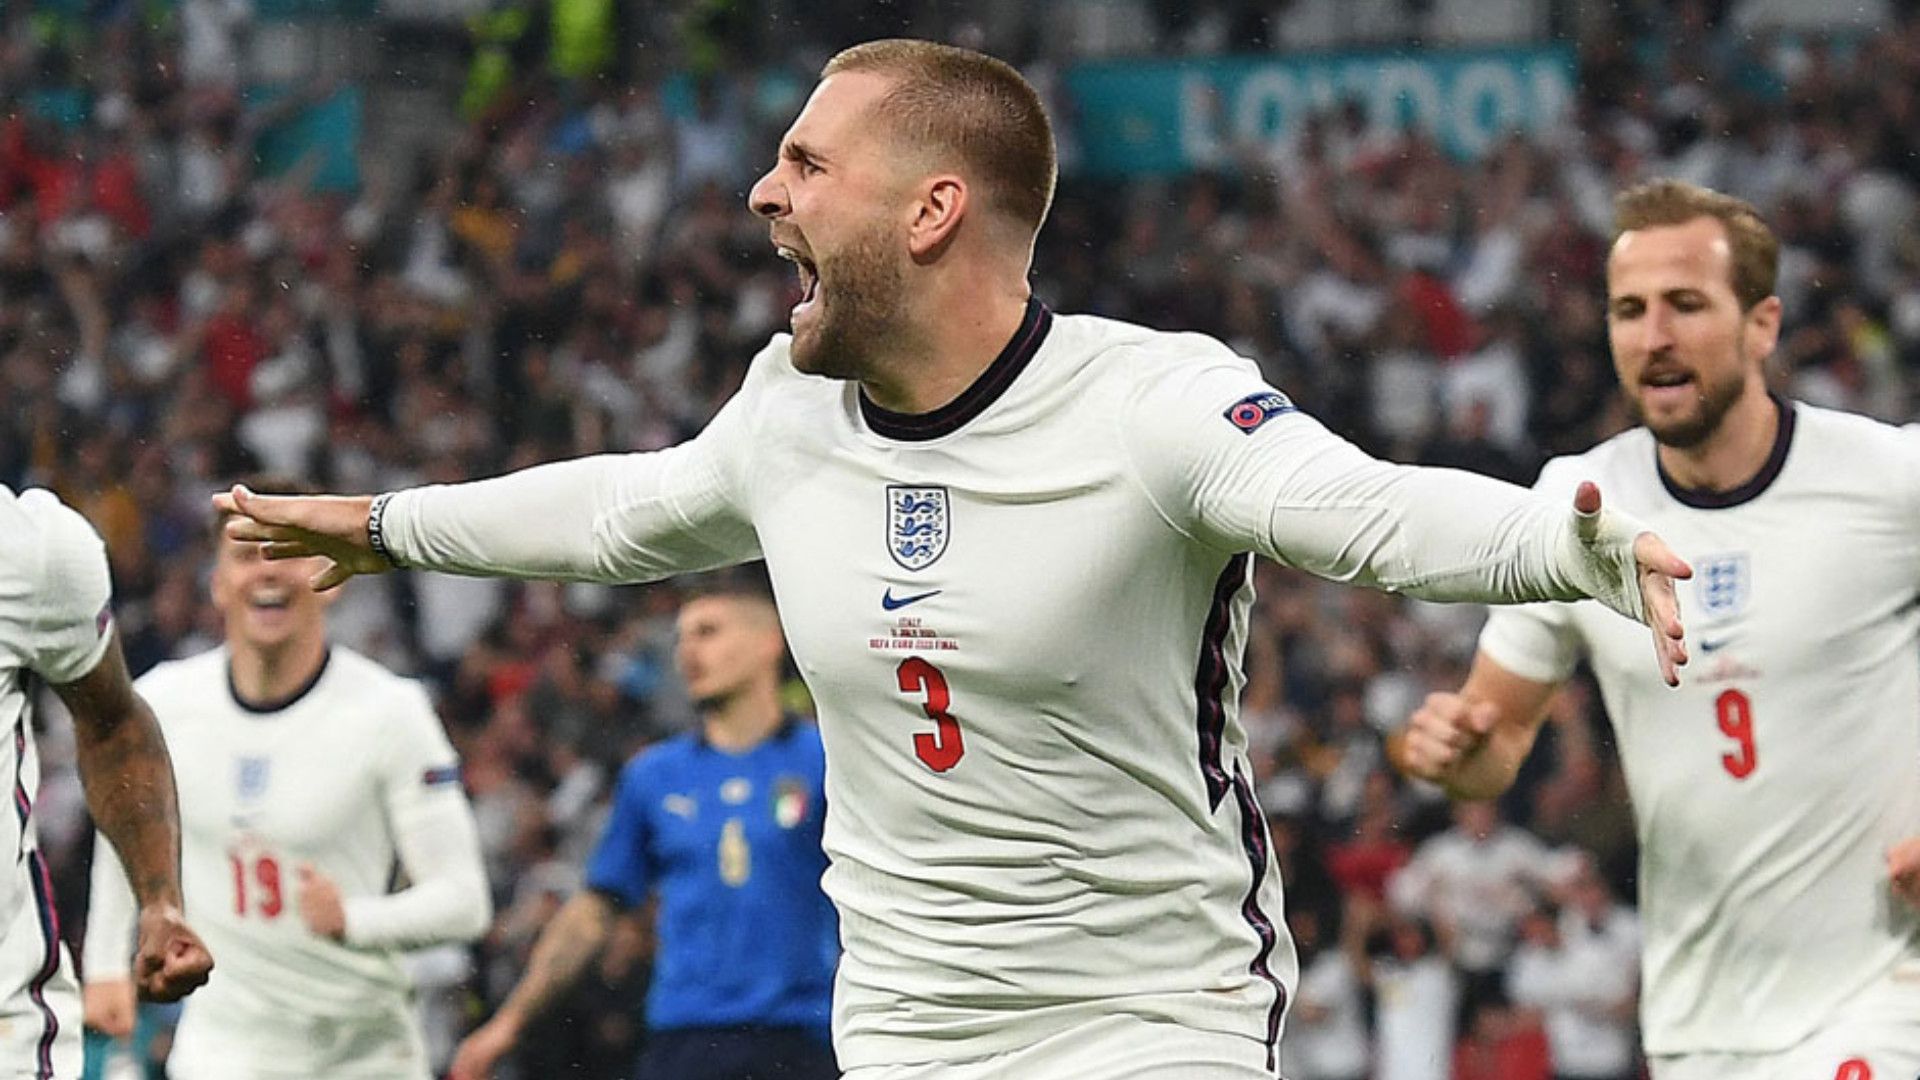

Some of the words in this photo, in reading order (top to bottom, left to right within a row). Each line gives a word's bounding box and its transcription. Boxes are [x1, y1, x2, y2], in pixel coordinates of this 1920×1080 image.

[896, 656, 965, 773] 3
[1714, 688, 1756, 779] 9
[229, 850, 283, 919] 19
